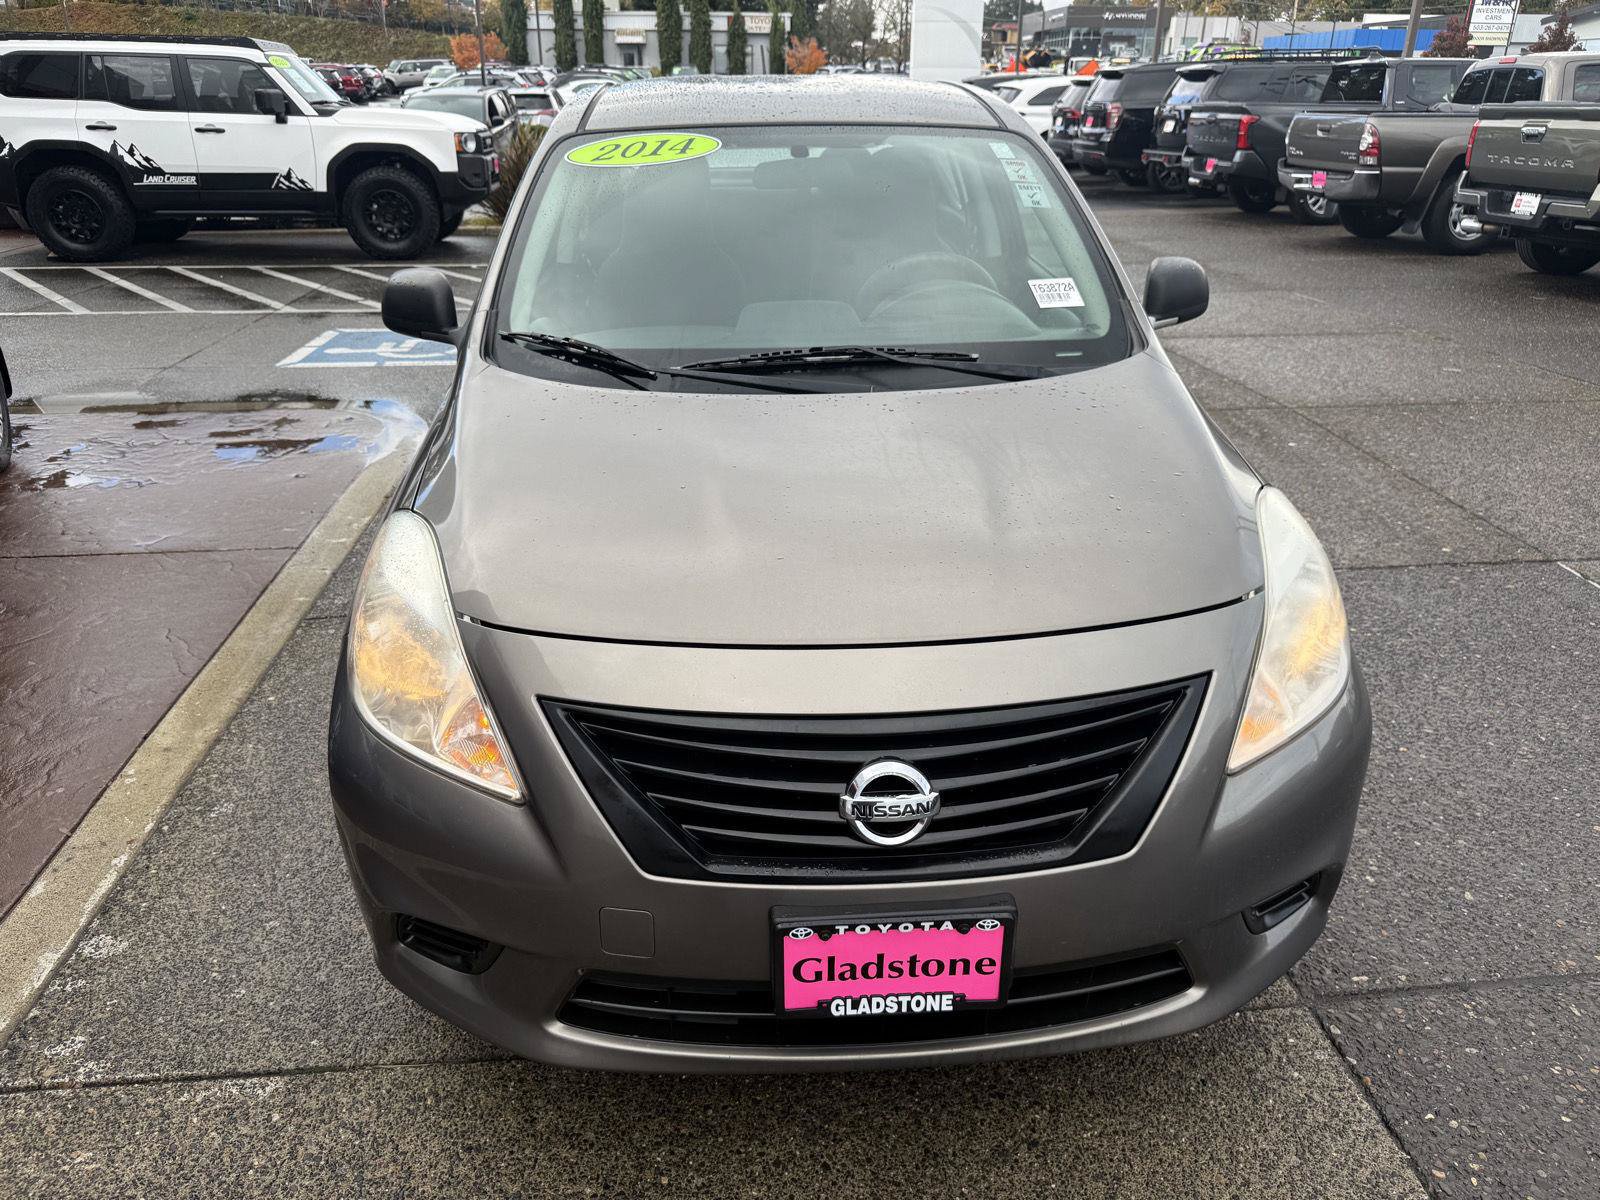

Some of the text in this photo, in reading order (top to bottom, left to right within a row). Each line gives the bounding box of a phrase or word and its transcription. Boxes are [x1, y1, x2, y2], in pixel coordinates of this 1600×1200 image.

[750, 16, 771, 24] TOYO
[590, 137, 695, 162] 2014
[1487, 154, 1575, 169] TACOMA
[143, 174, 197, 184] LAND CRUISER
[1031, 282, 1076, 293] T63872A
[851, 801, 930, 818] NISSAN
[835, 920, 954, 935] TOYOTA
[792, 953, 997, 983] Gladstone
[830, 994, 954, 1017] GLADSTONE
